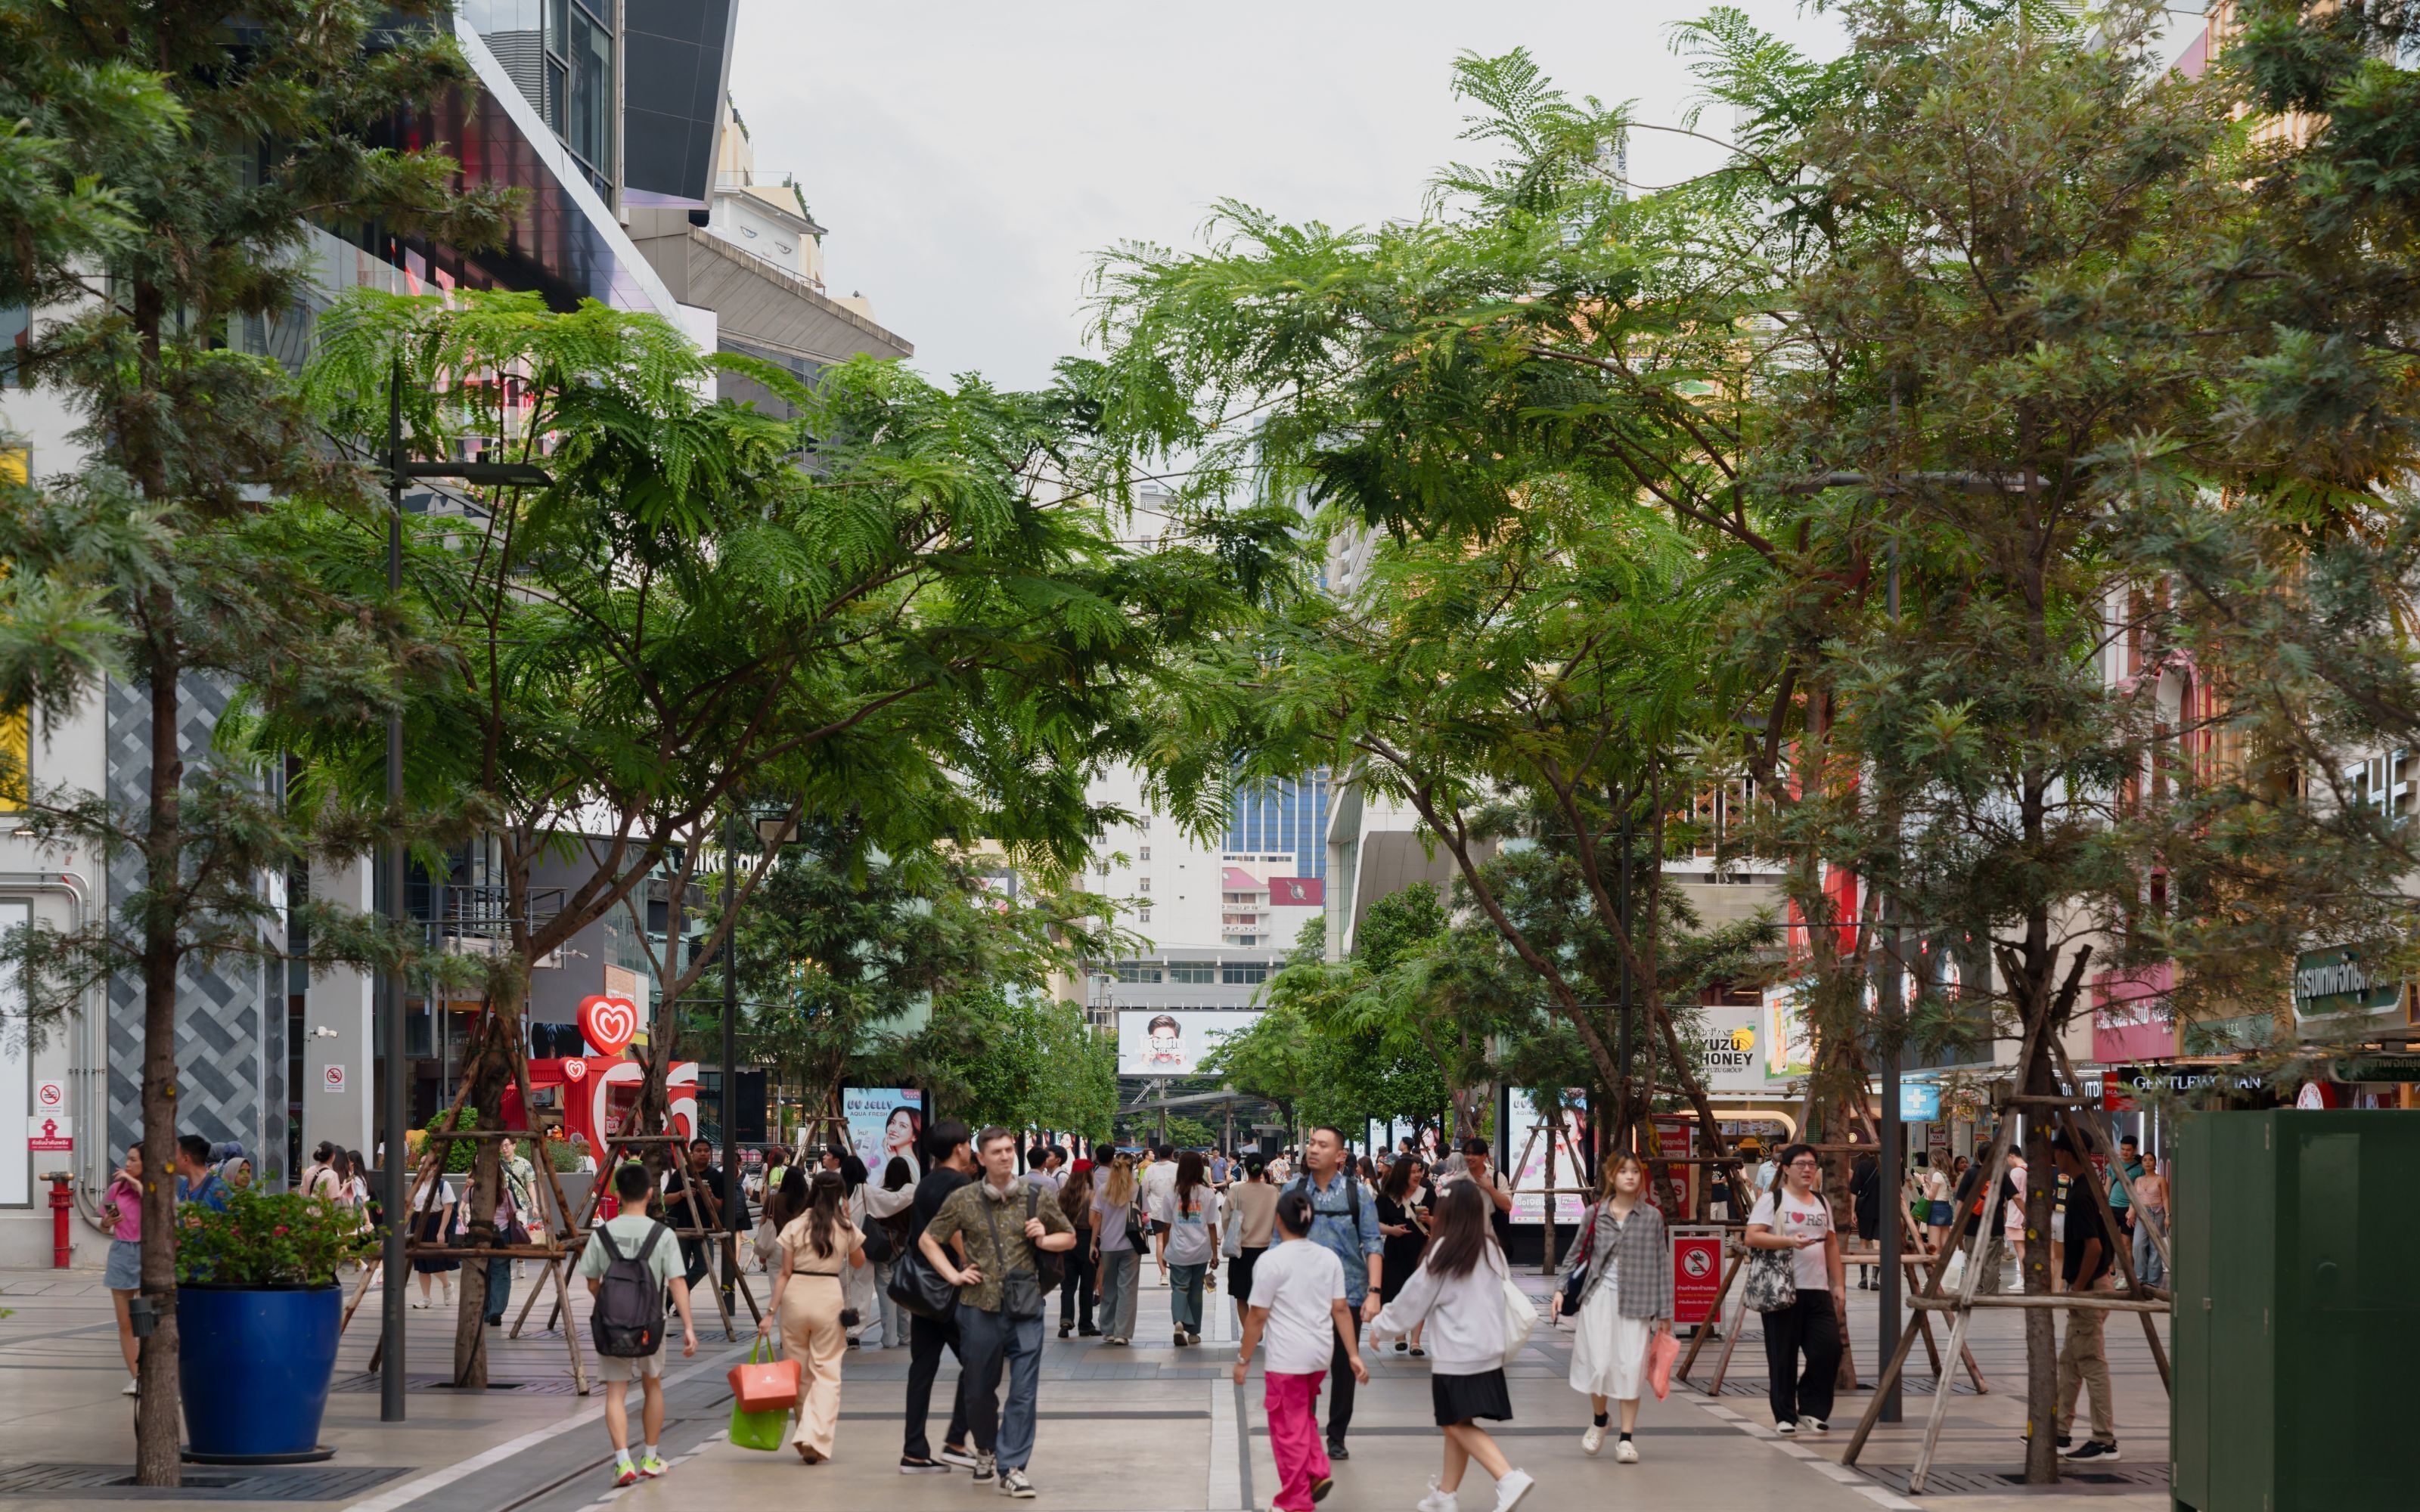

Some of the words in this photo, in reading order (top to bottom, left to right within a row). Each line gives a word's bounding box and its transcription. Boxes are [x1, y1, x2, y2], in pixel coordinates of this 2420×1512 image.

[1699, 1039, 1740, 1051] YUZU
[1699, 1053, 1754, 1065] HONEY
[864, 1100, 893, 1110] JELLY
